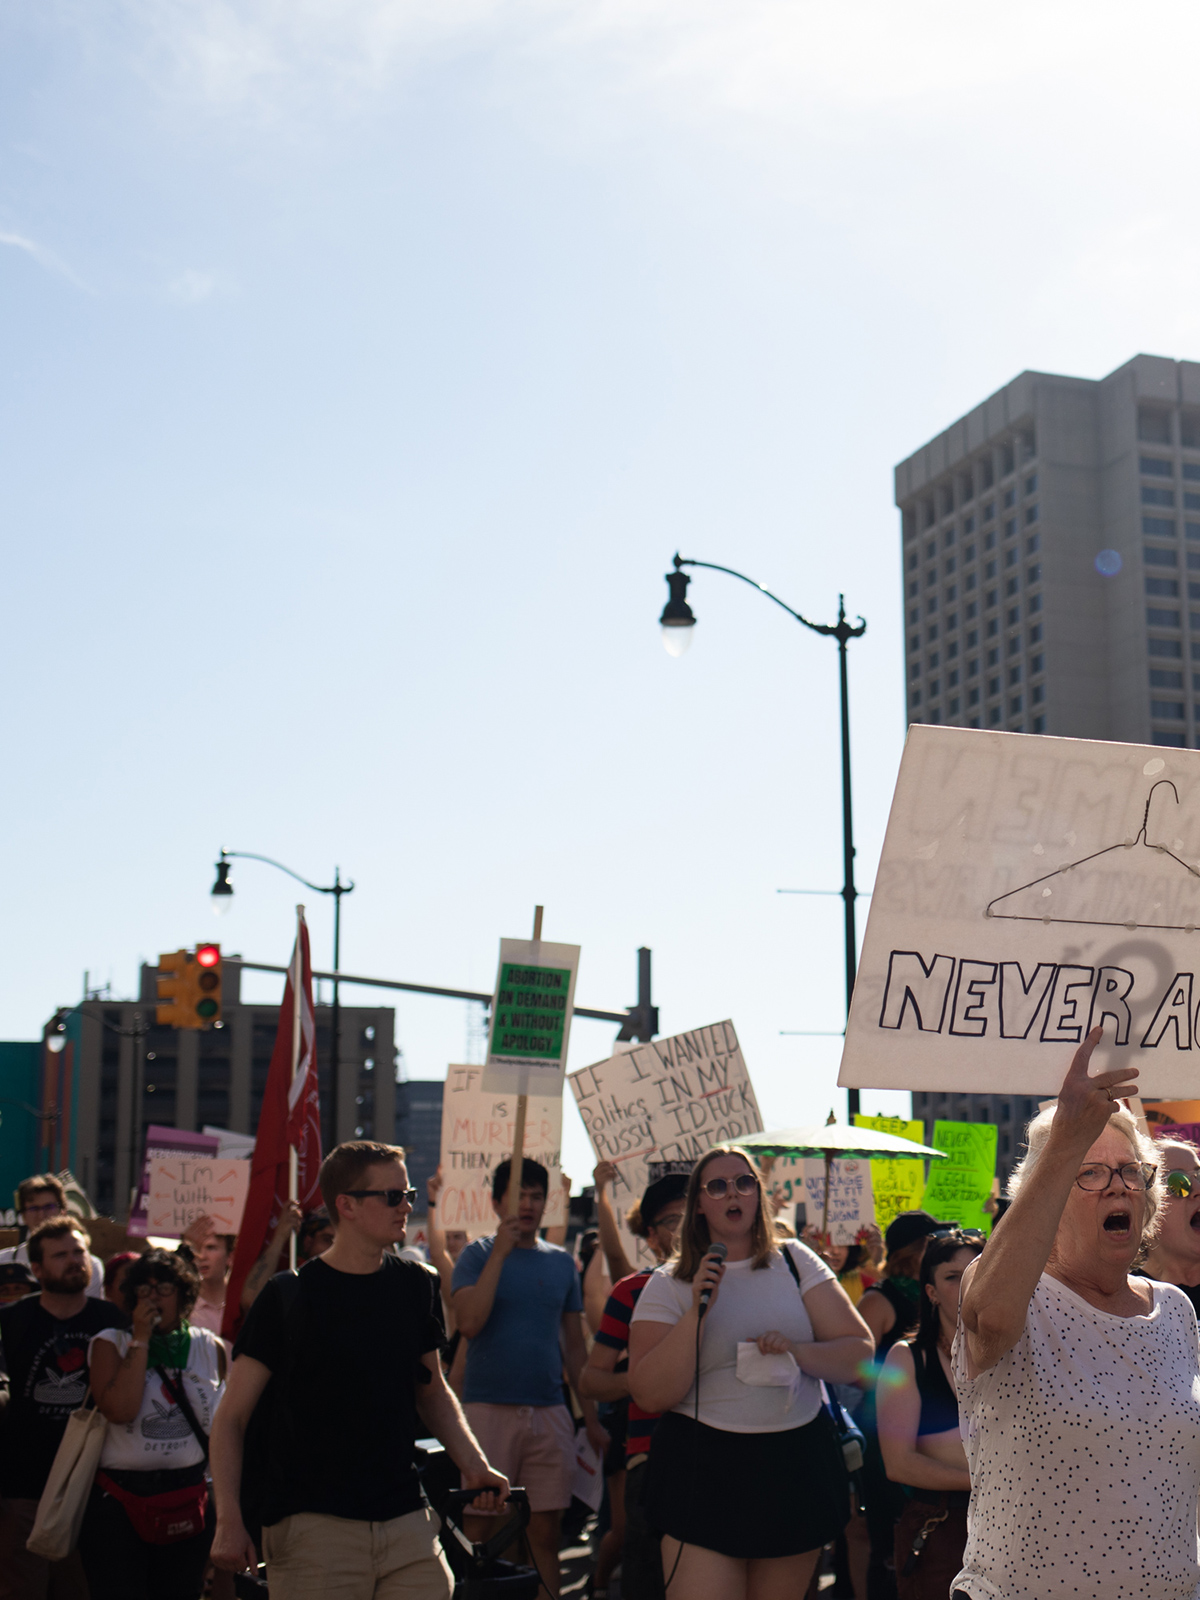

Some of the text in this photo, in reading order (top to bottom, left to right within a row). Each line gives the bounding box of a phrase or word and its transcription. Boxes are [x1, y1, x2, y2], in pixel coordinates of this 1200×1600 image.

[879, 949, 1135, 1046] NEVER
[652, 1021, 740, 1070] WANTED
[452, 1069, 480, 1093] IF
[652, 1070, 693, 1107] IN
[697, 1056, 729, 1095] MY
[492, 1102, 508, 1118] IS
[706, 1080, 754, 1122] FUCK
[447, 1150, 492, 1170] THEN
[39, 1405, 71, 1415] DETRO
[144, 1440, 189, 1452] DETROIT
